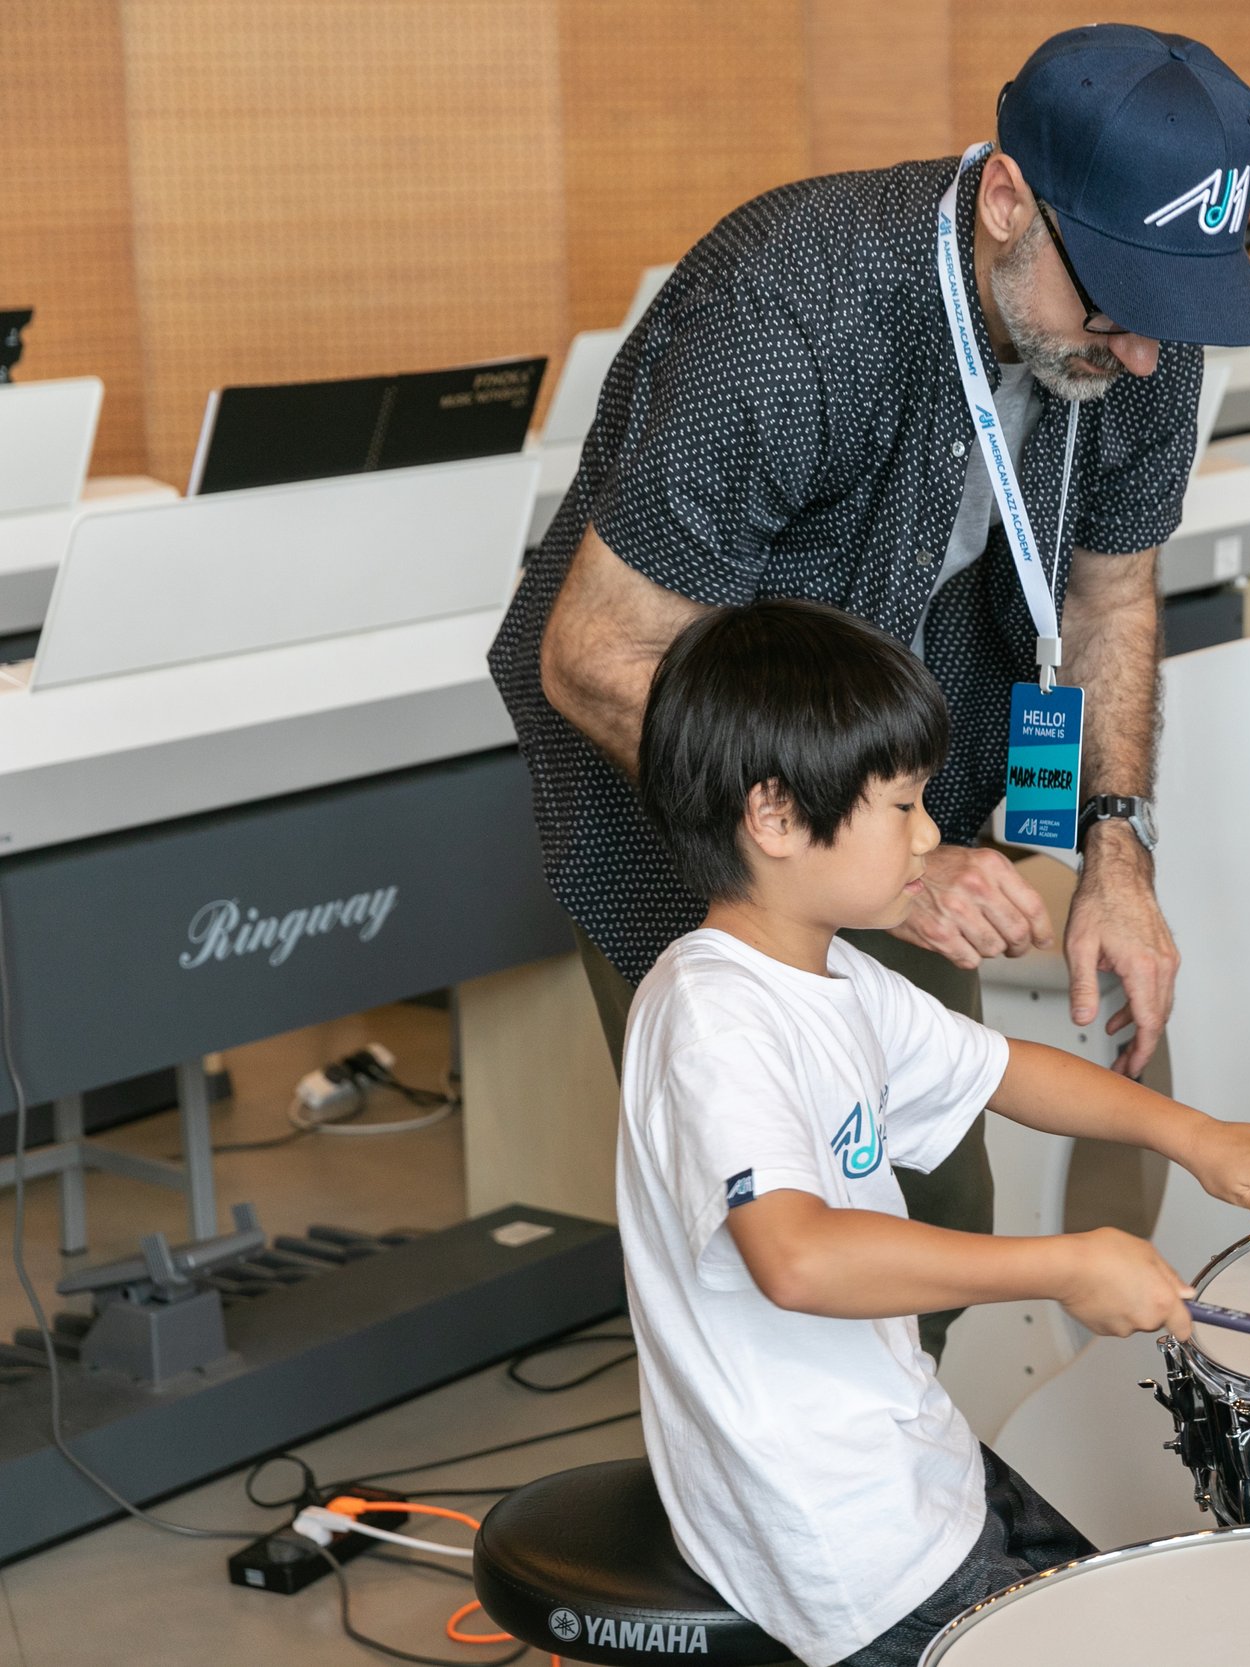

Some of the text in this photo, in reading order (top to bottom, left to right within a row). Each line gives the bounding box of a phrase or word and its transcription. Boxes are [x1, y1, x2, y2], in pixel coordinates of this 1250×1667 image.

[943, 240, 959, 296] AMERICAN
[953, 296, 961, 323] JAZZ
[959, 324, 978, 378] ACADEMY
[988, 433, 1007, 486] AMERICAN
[1004, 485, 1017, 510] JAZZ
[1011, 514, 1032, 562] ACADEMY
[1023, 710, 1066, 728] HELLO!
[1023, 727, 1064, 738] MY NAME IS
[1009, 766, 1072, 791] MARK FERBER
[1040, 819, 1060, 827] AMERICAN
[178, 885, 398, 970] Ringway
[584, 1615, 708, 1654] YAMAHA
